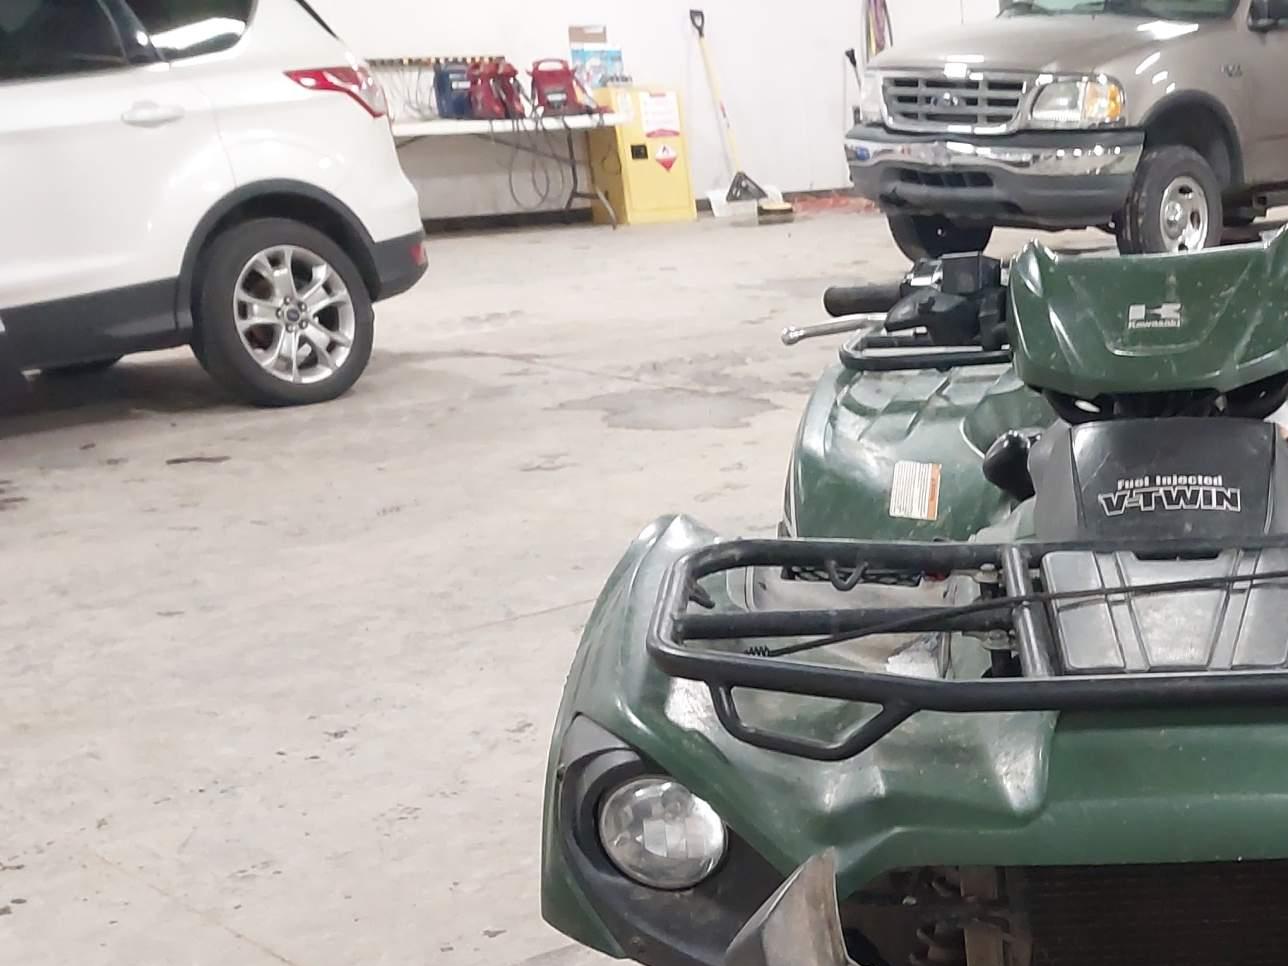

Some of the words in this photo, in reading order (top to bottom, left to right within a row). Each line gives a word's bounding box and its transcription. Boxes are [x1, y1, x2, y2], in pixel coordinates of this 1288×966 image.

[1117, 475, 1150, 490] Fuel
[1155, 473, 1223, 487] Injected
[1098, 485, 1241, 517] V-TWIN
